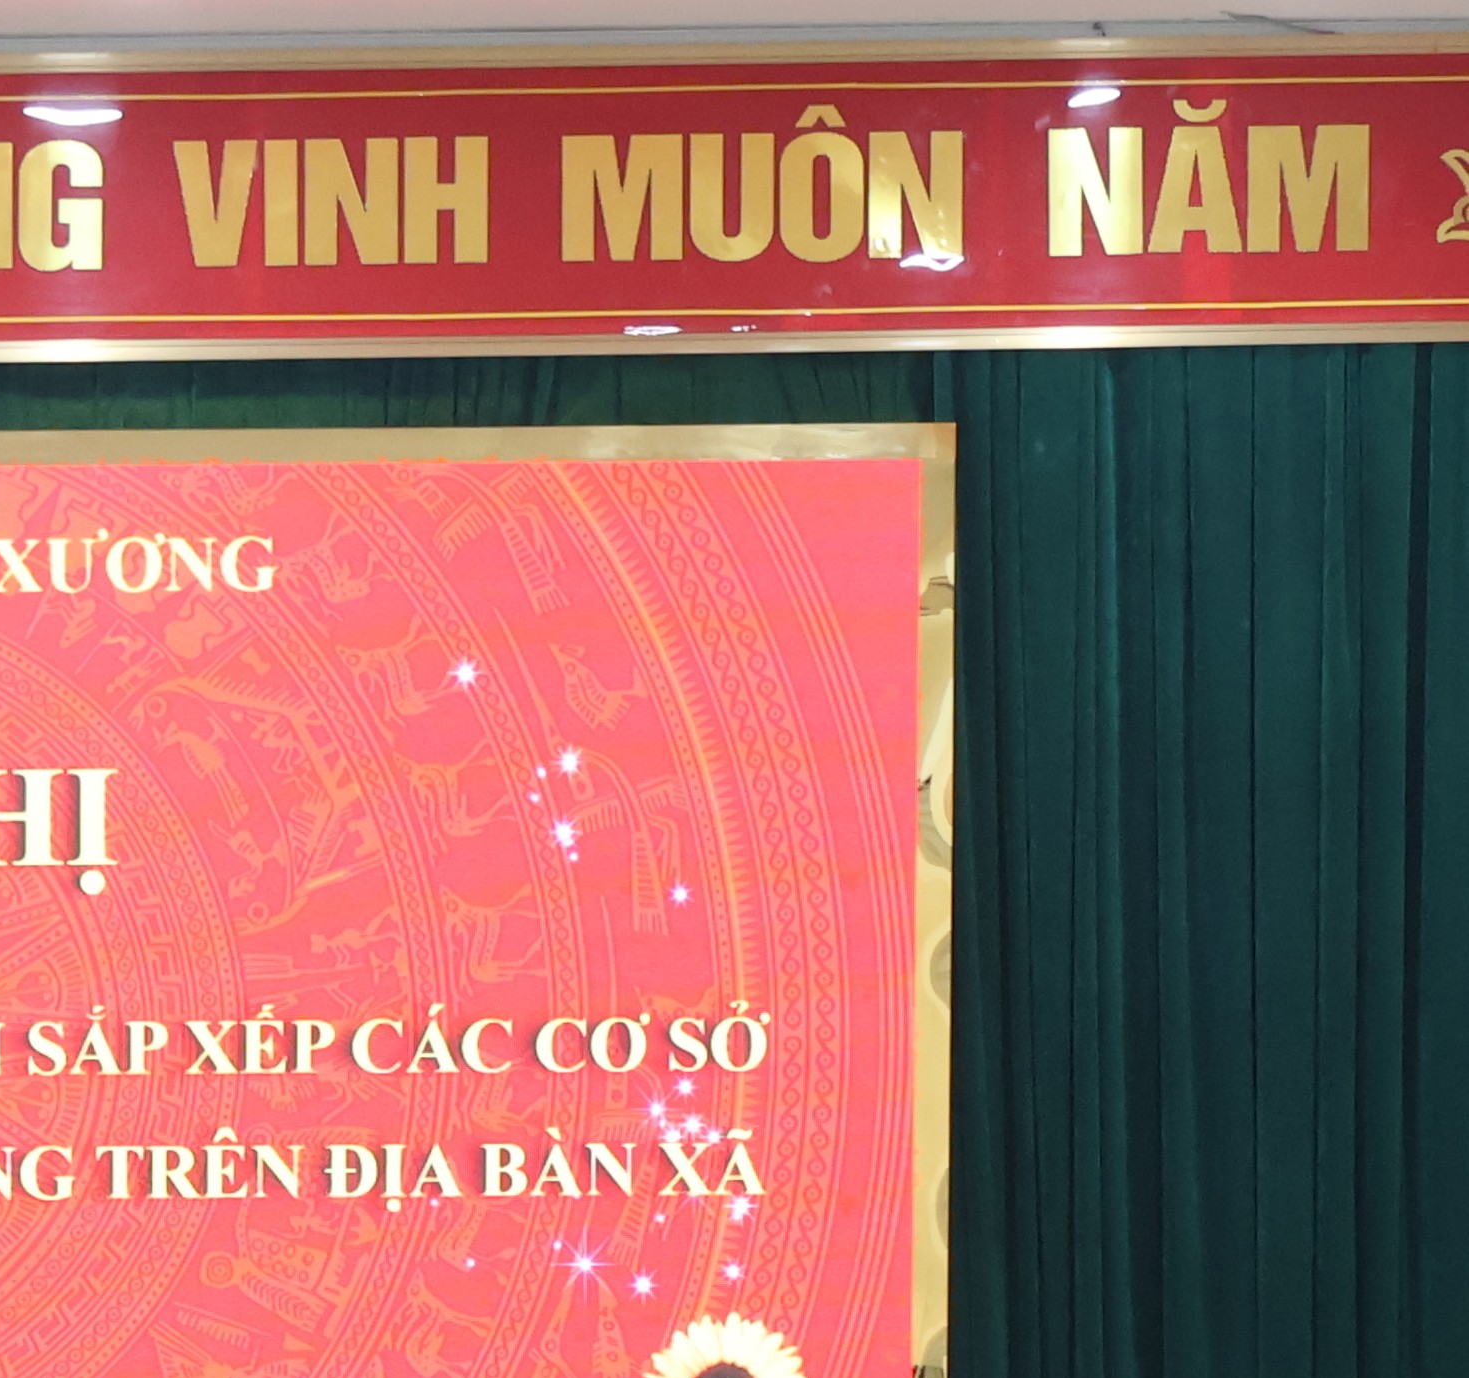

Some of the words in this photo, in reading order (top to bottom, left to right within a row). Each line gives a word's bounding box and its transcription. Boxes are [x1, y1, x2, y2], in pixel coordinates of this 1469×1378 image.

[173, 136, 489, 268] VINH
[561, 104, 964, 263] MUÔN
[1048, 99, 1370, 258] NĂM
[27, 1004, 169, 1076] SẮP
[185, 1003, 337, 1075] XẾP
[351, 1003, 513, 1074] CÁC
[535, 1011, 651, 1073] CƠ
[668, 1000, 771, 1072] SỞ
[95, 1127, 304, 1200] TRÊN
[323, 1143, 463, 1212] ĐỊA
[481, 1127, 636, 1198] BÀN
[656, 1130, 765, 1197] XÃ
